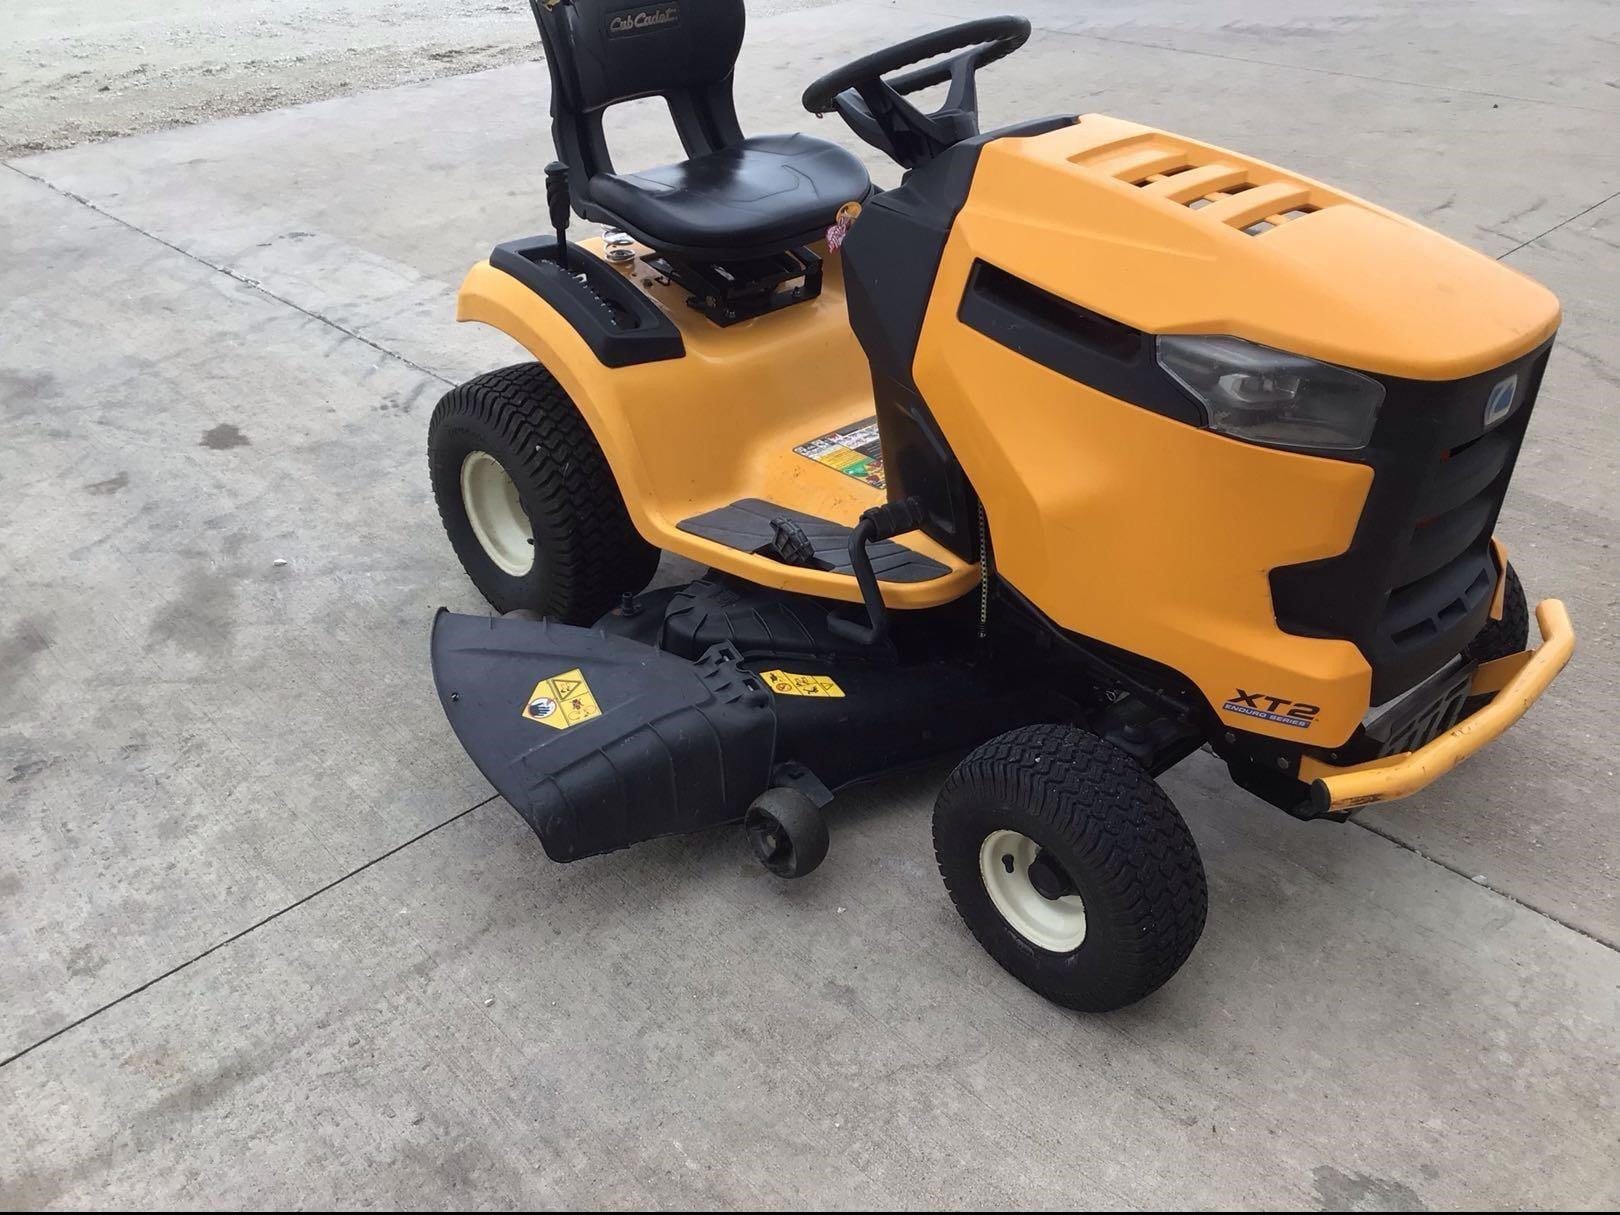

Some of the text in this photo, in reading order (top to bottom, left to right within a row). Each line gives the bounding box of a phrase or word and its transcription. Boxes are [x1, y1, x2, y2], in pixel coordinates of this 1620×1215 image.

[610, 8, 676, 33] Cub Cadet
[1224, 704, 1307, 727] ENDURO SERIES
[1227, 688, 1320, 721] XT2
